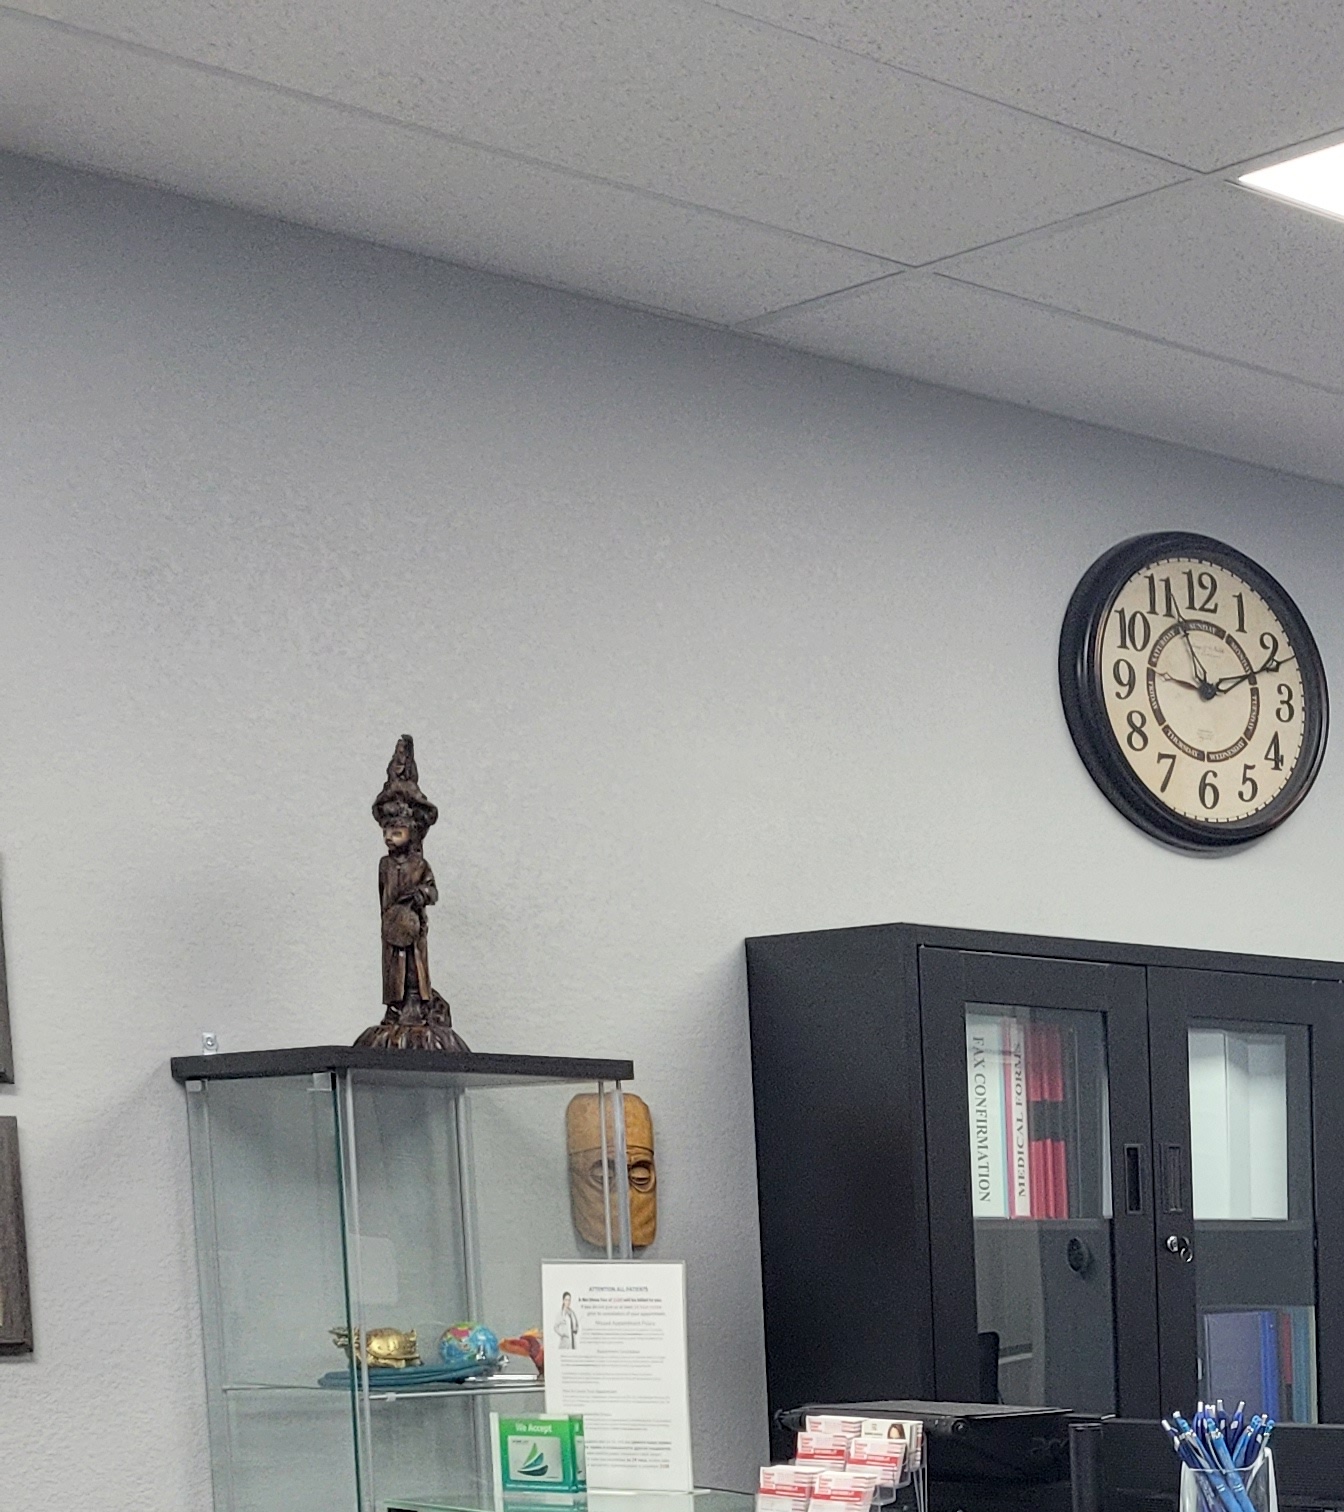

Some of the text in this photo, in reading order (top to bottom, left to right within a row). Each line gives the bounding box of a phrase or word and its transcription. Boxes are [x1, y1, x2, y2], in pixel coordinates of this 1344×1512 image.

[1144, 573, 1175, 618] 11
[1181, 569, 1218, 614] 12
[1232, 591, 1248, 633] 1
[1114, 607, 1150, 652] 10
[1259, 632, 1280, 672] 2
[1112, 658, 1136, 700] 9
[1275, 683, 1295, 722] 3
[1126, 710, 1149, 751] 8
[1264, 730, 1284, 771] 4
[1156, 752, 1177, 793] 7
[1198, 769, 1220, 810] 6
[1237, 763, 1258, 802] 5
[972, 1036, 991, 1202] FAX CONFIRMATION
[1014, 1042, 1026, 1197] MEDICAL FORMS
[515, 1422, 553, 1434] We Accept
